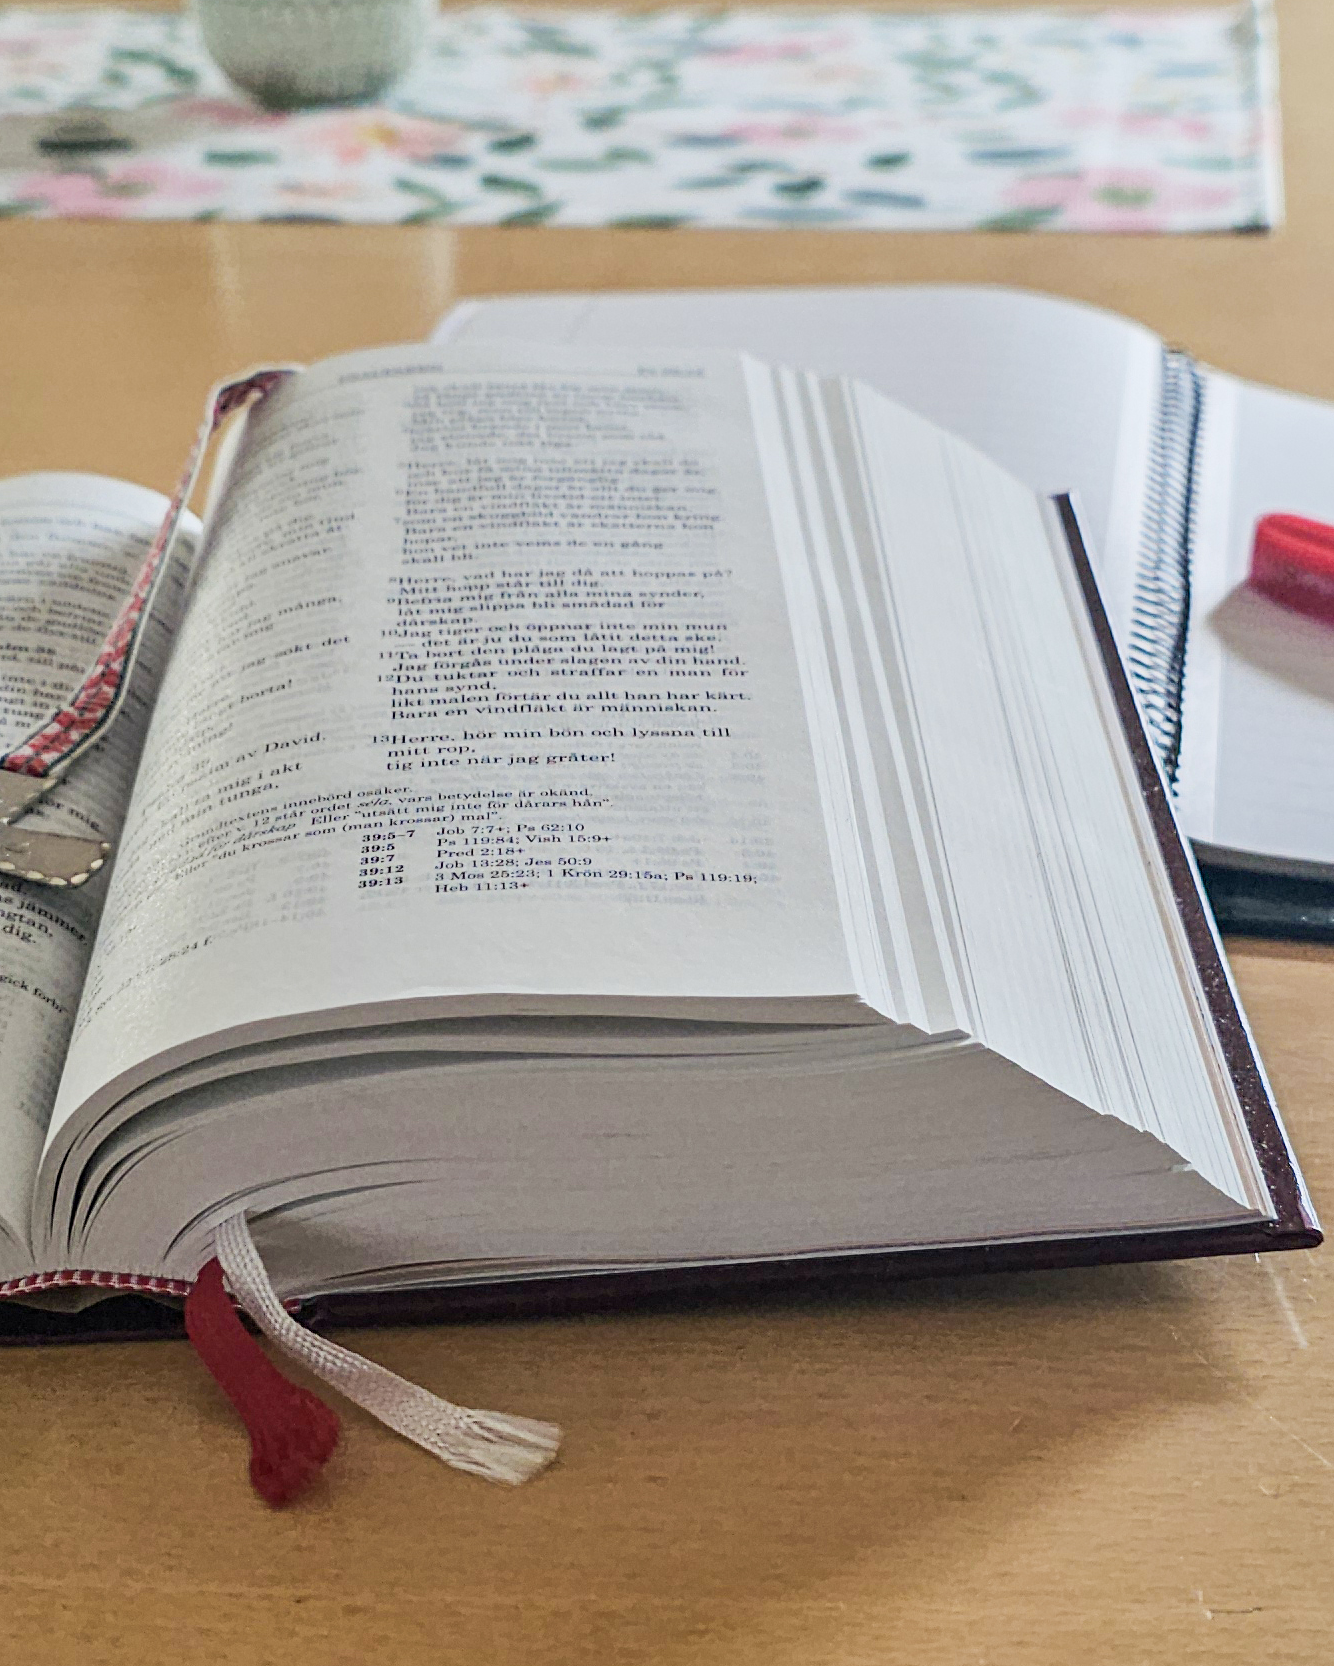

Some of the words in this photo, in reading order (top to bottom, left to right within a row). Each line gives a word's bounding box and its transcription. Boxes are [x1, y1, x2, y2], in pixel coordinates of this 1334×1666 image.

[392, 662, 428, 672] Jag
[498, 657, 555, 665] under
[656, 656, 687, 665] din
[435, 670, 498, 681] tuktar
[508, 668, 540, 677] och
[550, 667, 628, 677] straffar
[670, 669, 711, 677] man
[391, 687, 438, 695] hans
[391, 698, 424, 708] likt
[430, 694, 489, 705] malen
[556, 691, 579, 700] du
[586, 691, 618, 700] allt
[625, 691, 661, 700] han
[667, 691, 700, 700] har
[391, 710, 438, 720] Bara
[445, 708, 468, 716] en
[475, 704, 566, 714] vindfläkt
[573, 704, 595, 712] är
[463, 730, 497, 740] hör
[504, 729, 542, 738] min
[549, 727, 584, 737] bön
[591, 727, 624, 737] och
[632, 727, 695, 739] lyssna
[702, 727, 731, 737] till
[388, 746, 430, 757] mitt
[387, 761, 412, 771] tig
[420, 758, 460, 768] inte
[467, 755, 502, 765] när
[507, 755, 539, 766] jag
[283, 790, 352, 810] innebörd
[310, 803, 351, 814] ordet
[398, 796, 432, 804] vars
[438, 790, 513, 801] betydelse
[416, 804, 445, 813] mig
[450, 801, 482, 811] inte
[304, 827, 336, 837] som
[436, 827, 465, 836] Job
[517, 824, 536, 832] Ps
[541, 823, 585, 832] 62:10
[361, 843, 396, 854] 39:5
[437, 838, 456, 847] Ps
[525, 835, 562, 843] Vish
[569, 834, 612, 843] 15:9+
[360, 854, 395, 865] 39:7
[436, 848, 474, 858] Pred
[480, 847, 526, 856] 2:18+
[358, 864, 405, 877] 39:12
[435, 860, 464, 870] Job
[524, 858, 552, 866] Jes
[557, 857, 592, 866] 50:9
[357, 876, 403, 889] 39:13
[435, 872, 444, 881] 3
[450, 871, 485, 880] Mos
[547, 869, 553, 877] 1
[562, 868, 602, 878] Krön
[675, 871, 694, 881] Ps
[435, 883, 468, 893] Heb
[476, 881, 529, 891] 11:13+
